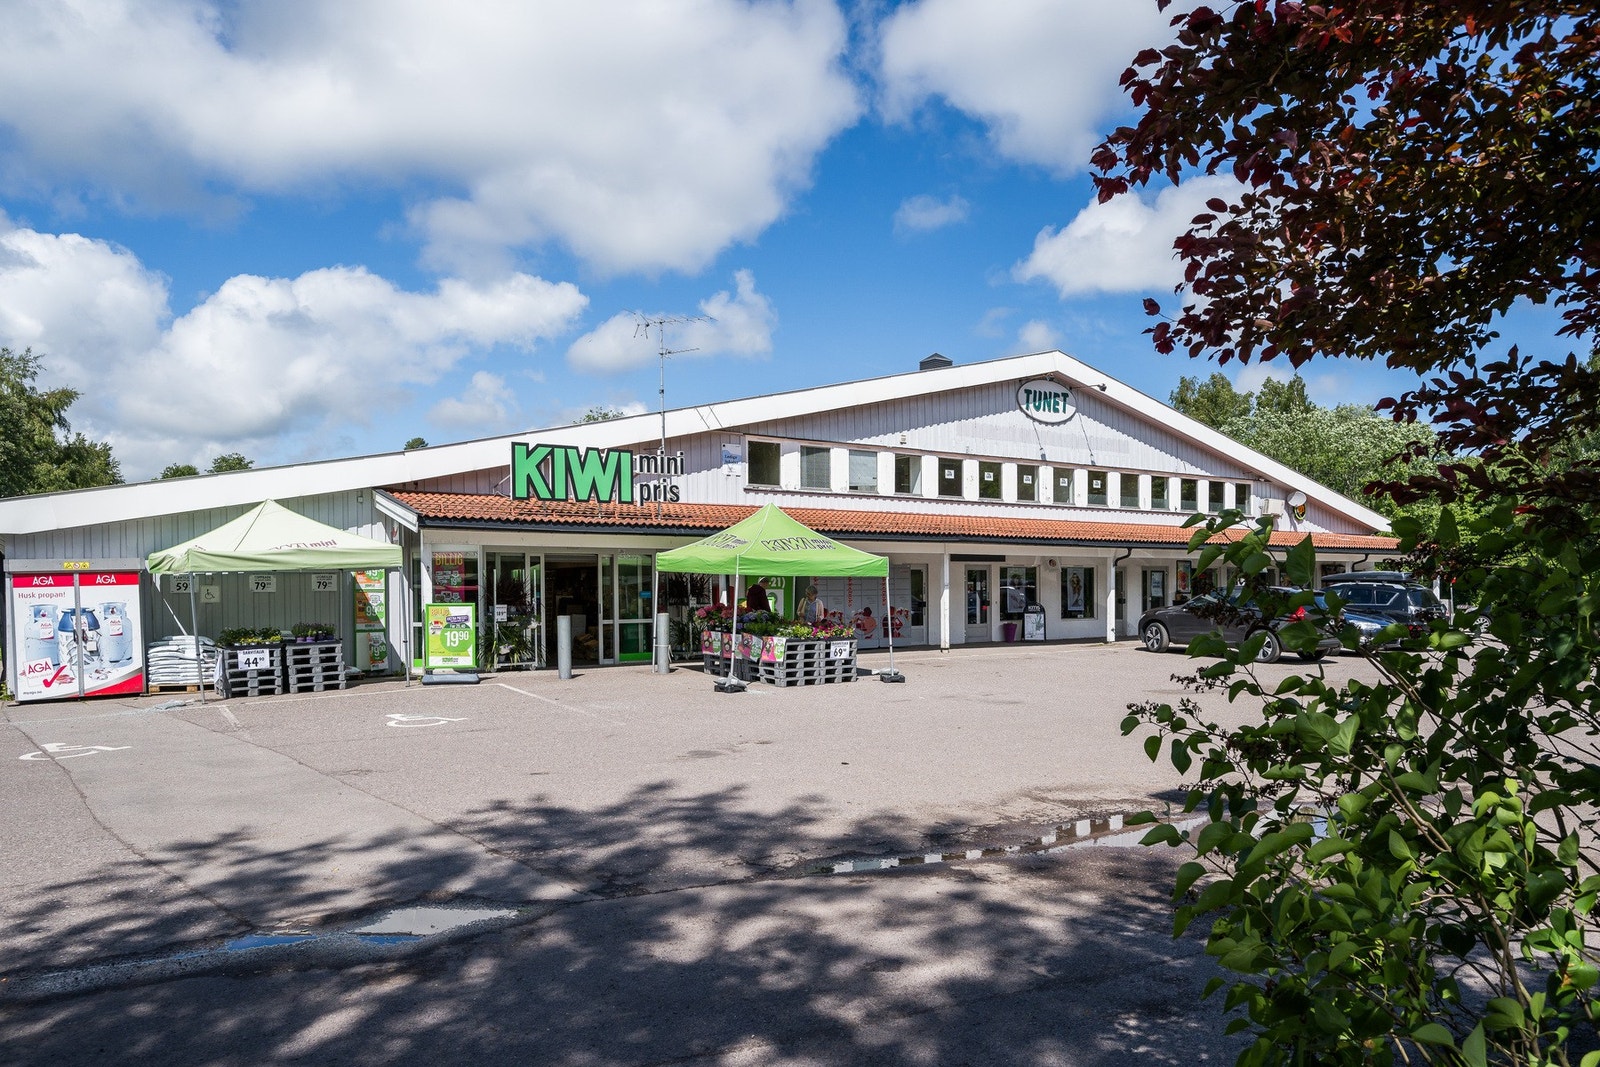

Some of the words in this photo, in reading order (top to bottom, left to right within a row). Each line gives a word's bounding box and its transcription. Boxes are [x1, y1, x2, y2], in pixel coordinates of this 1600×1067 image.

[1023, 388, 1070, 414] TUNET
[638, 450, 684, 475] mini
[511, 441, 634, 504] KIWI
[638, 478, 680, 506] pris
[760, 536, 816, 551] KIWI
[435, 553, 463, 566] BILLIG
[32, 576, 55, 586] AGA
[95, 575, 117, 584] AGA
[316, 581, 328, 589] 79
[176, 582, 188, 591] 59
[254, 581, 266, 590] 79
[38, 591, 66, 600] propan!
[444, 630, 459, 647] 19
[459, 630, 469, 640] 90
[833, 647, 843, 657] 69
[244, 657, 258, 667] 44
[28, 661, 52, 675] AGA
